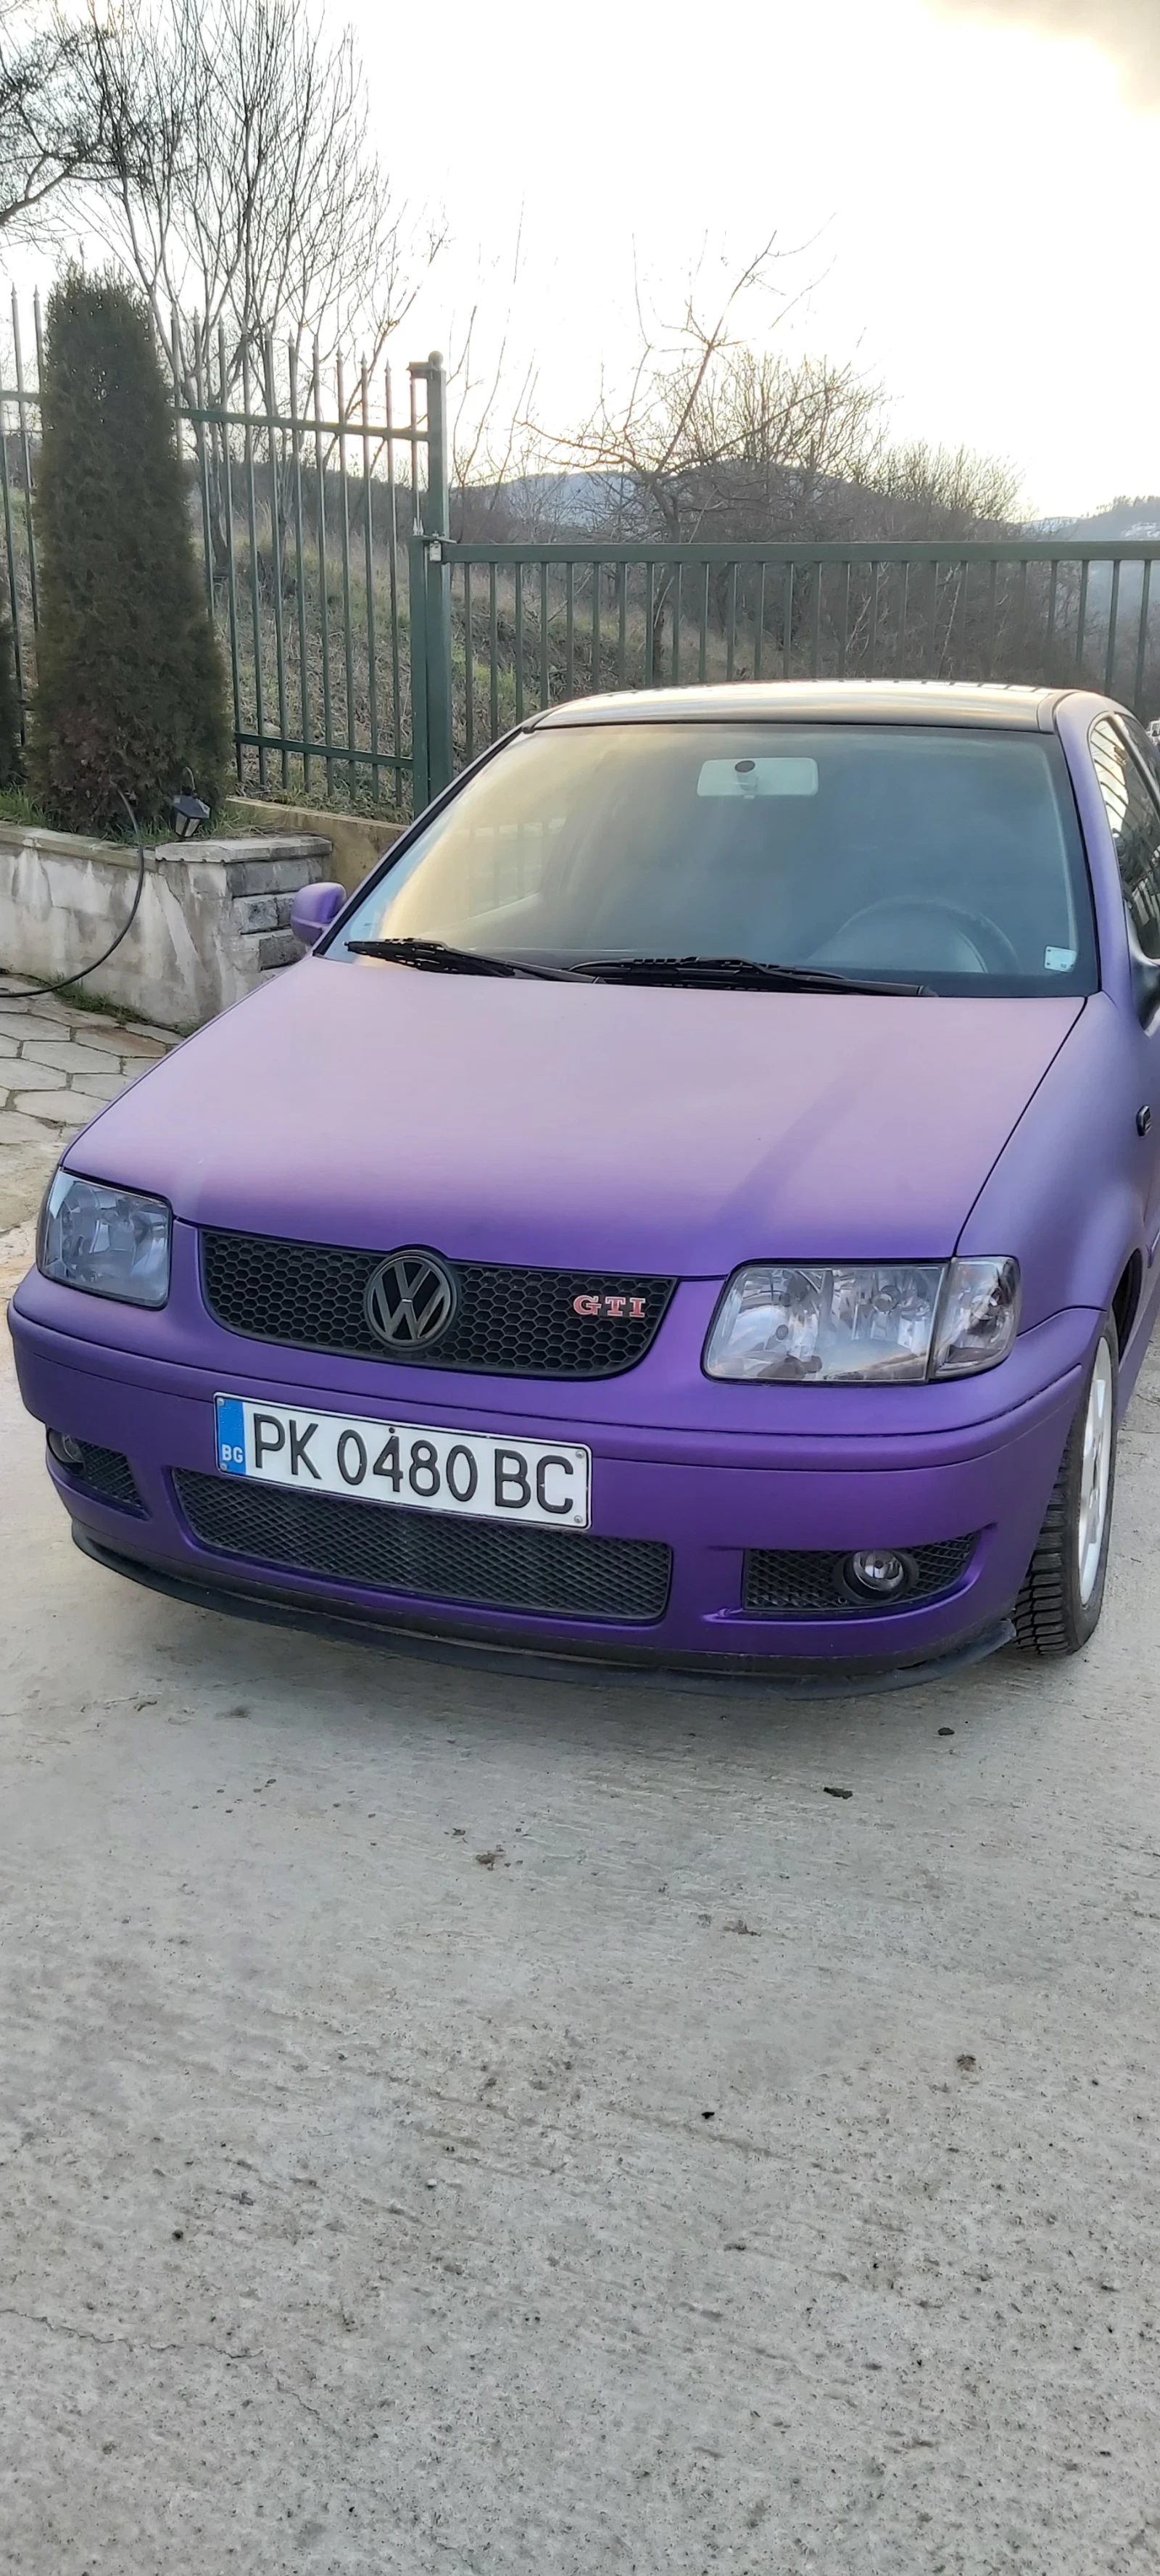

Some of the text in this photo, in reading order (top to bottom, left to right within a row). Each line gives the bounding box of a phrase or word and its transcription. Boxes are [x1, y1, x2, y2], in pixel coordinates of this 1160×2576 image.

[371, 1260, 453, 1343] VW
[572, 1294, 647, 1318] GTI
[221, 1443, 244, 1464] BG
[252, 1412, 574, 1514] PK 0480 BC
